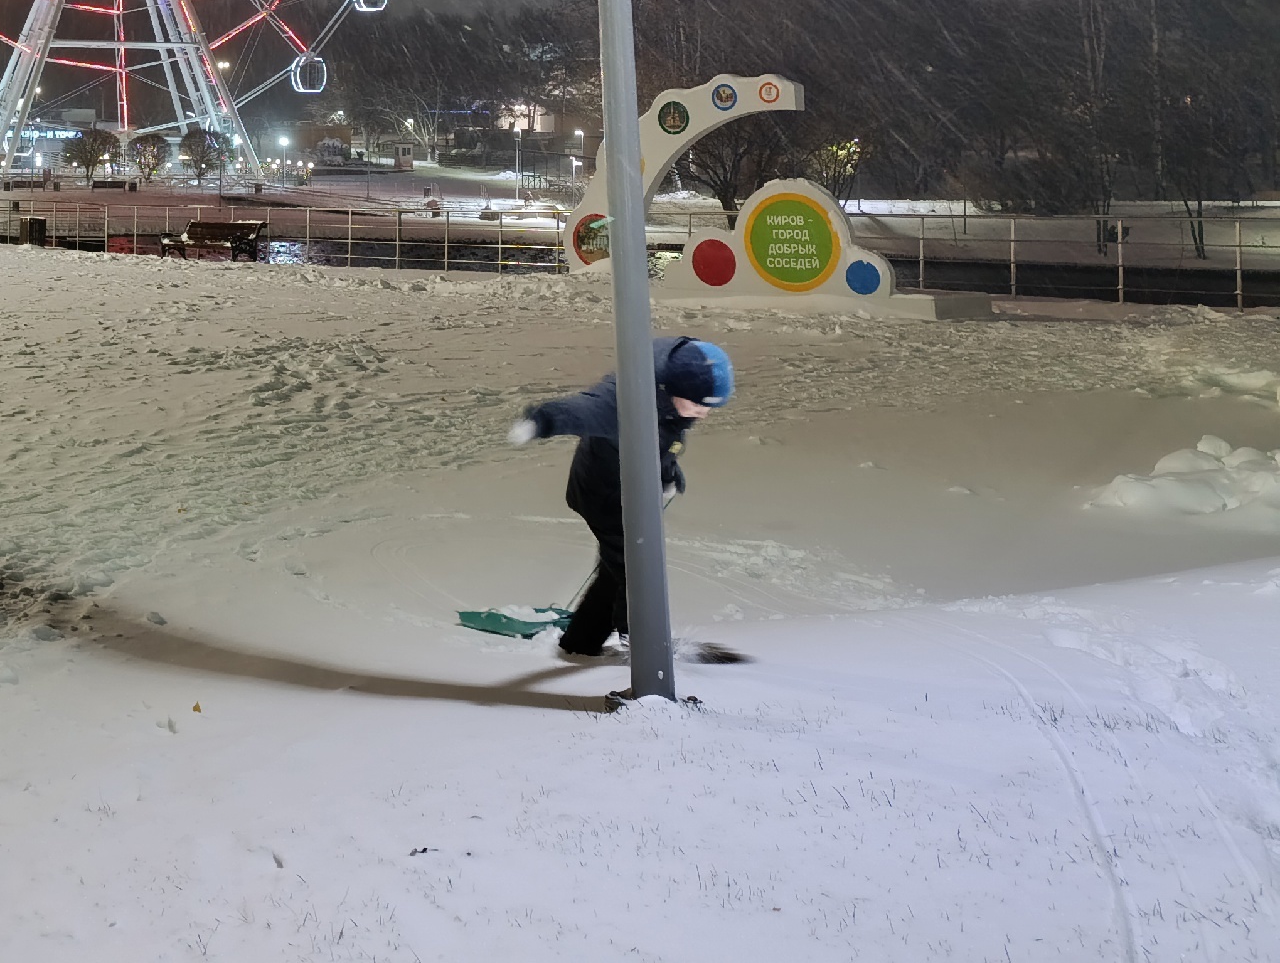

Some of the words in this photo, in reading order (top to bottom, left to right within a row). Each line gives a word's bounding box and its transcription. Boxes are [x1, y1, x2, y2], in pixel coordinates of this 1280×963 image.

[766, 215, 805, 226] КИРОВ
[772, 229, 810, 242] ГОРОД
[768, 243, 817, 255] ДОБРЫХ
[766, 256, 820, 270] СОСЕДЕЙ
